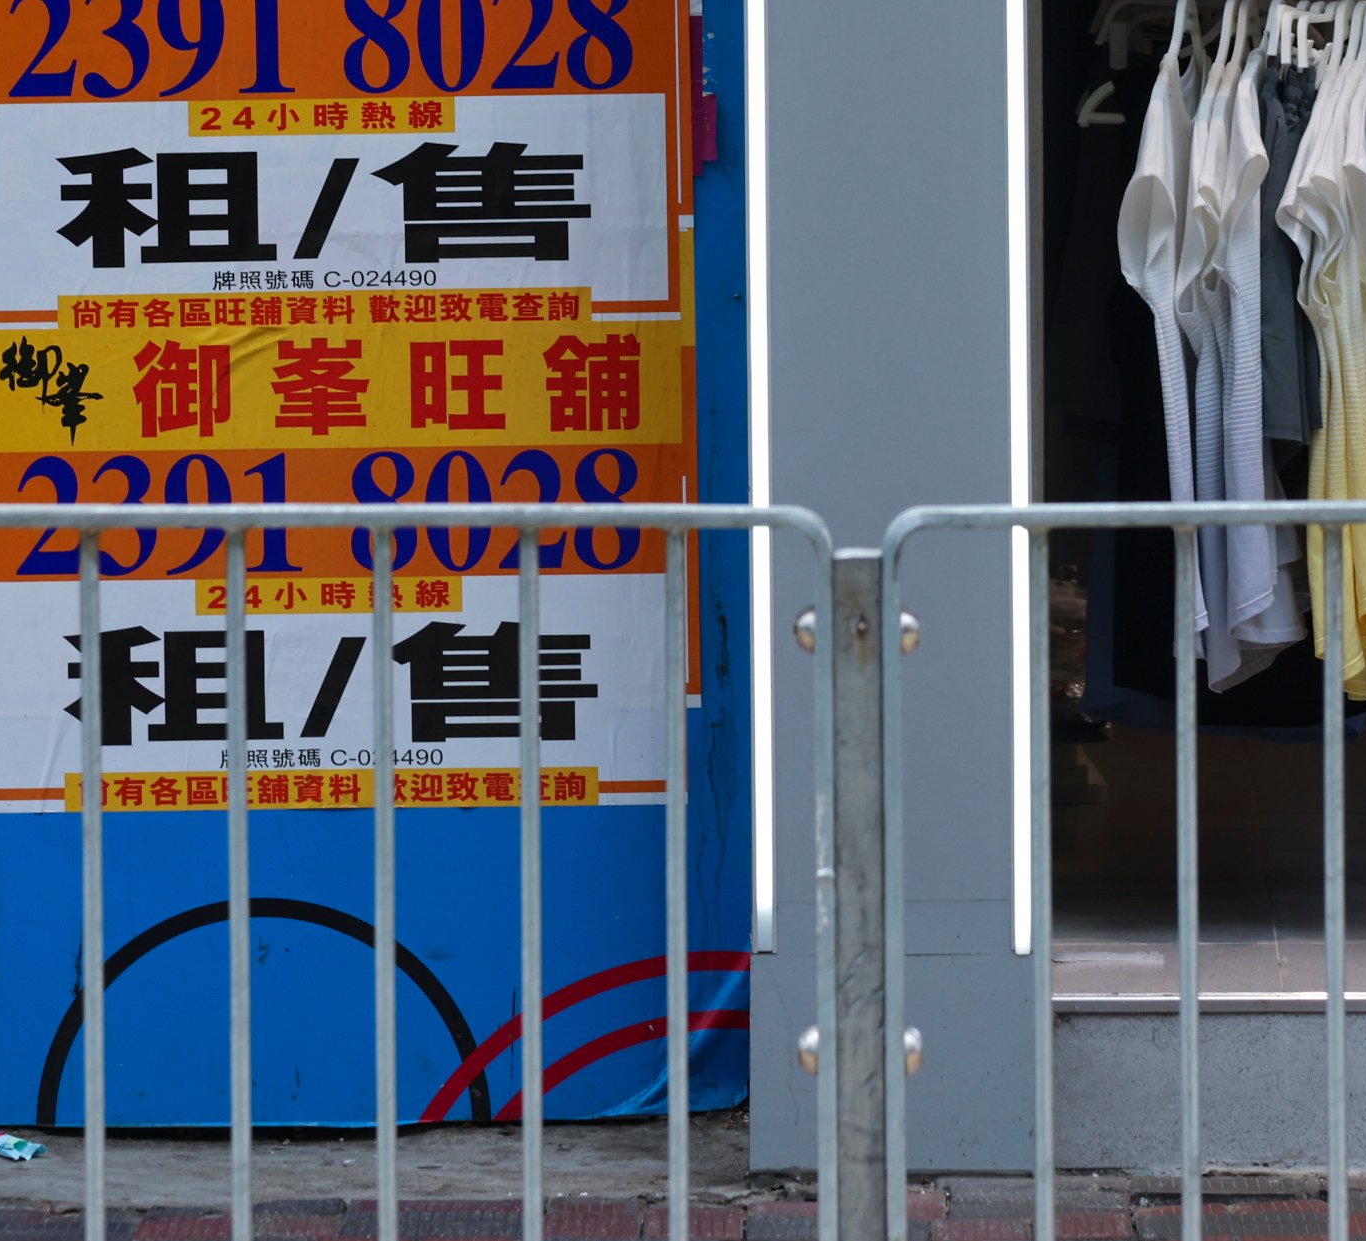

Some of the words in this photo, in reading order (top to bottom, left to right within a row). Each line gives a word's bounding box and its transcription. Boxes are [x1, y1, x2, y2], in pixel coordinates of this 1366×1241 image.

[212, 269, 315, 292] 牌照號碼
[323, 267, 437, 289] C-024490
[72, 296, 356, 329] 尚有各區旺舖資料
[369, 292, 581, 324] 歡迎致電查詢
[16, 452, 305, 577] 2391
[351, 448, 642, 572] 8028
[331, 747, 444, 768] C-04490
